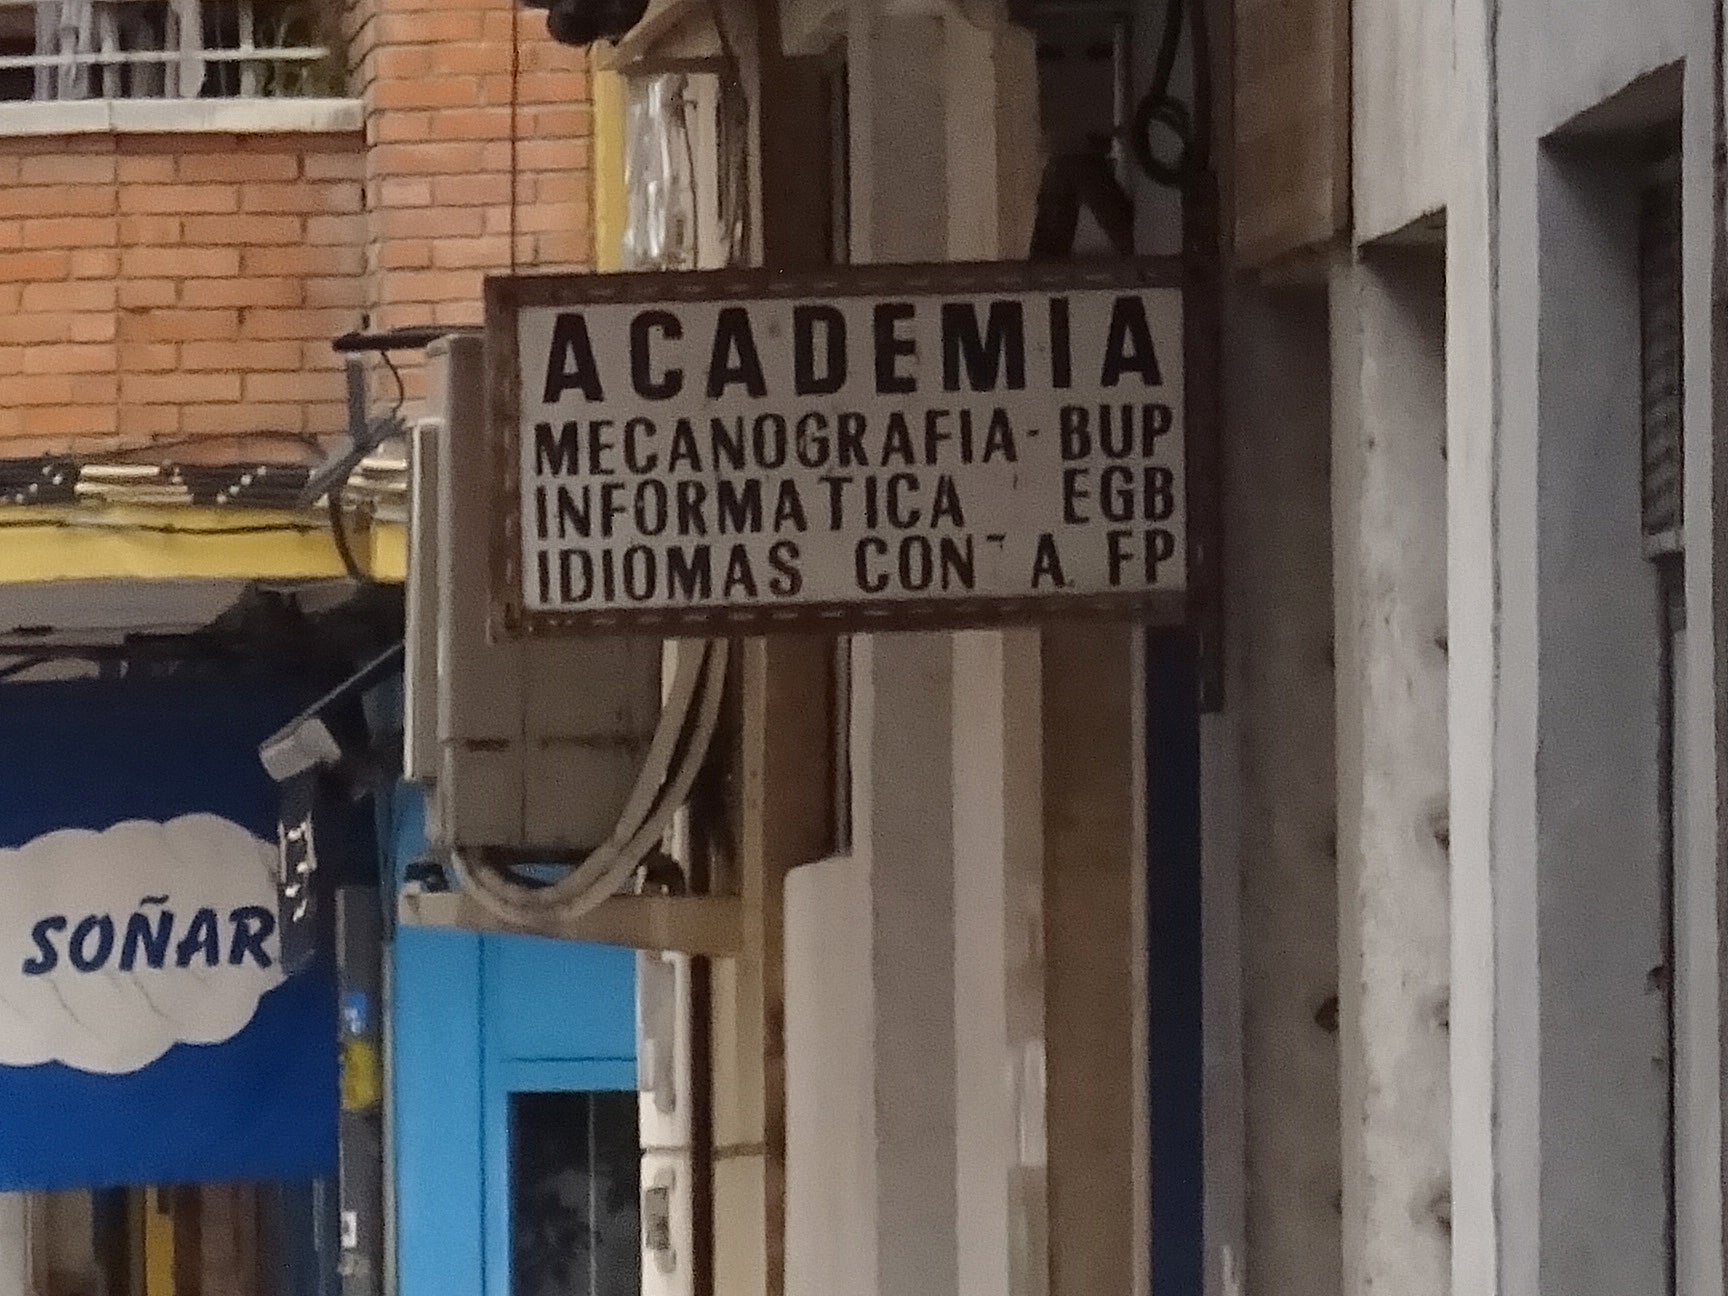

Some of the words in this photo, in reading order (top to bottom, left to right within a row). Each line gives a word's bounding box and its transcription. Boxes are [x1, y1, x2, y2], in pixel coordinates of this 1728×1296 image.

[542, 296, 1164, 403] ACADEMIA
[1060, 403, 1174, 461] BUP
[536, 473, 965, 540] INFORMATICA
[1062, 465, 1175, 525] EGB
[537, 538, 803, 604] IDIOMAS
[1106, 528, 1176, 588] FP
[21, 894, 277, 977] SOÑAR
